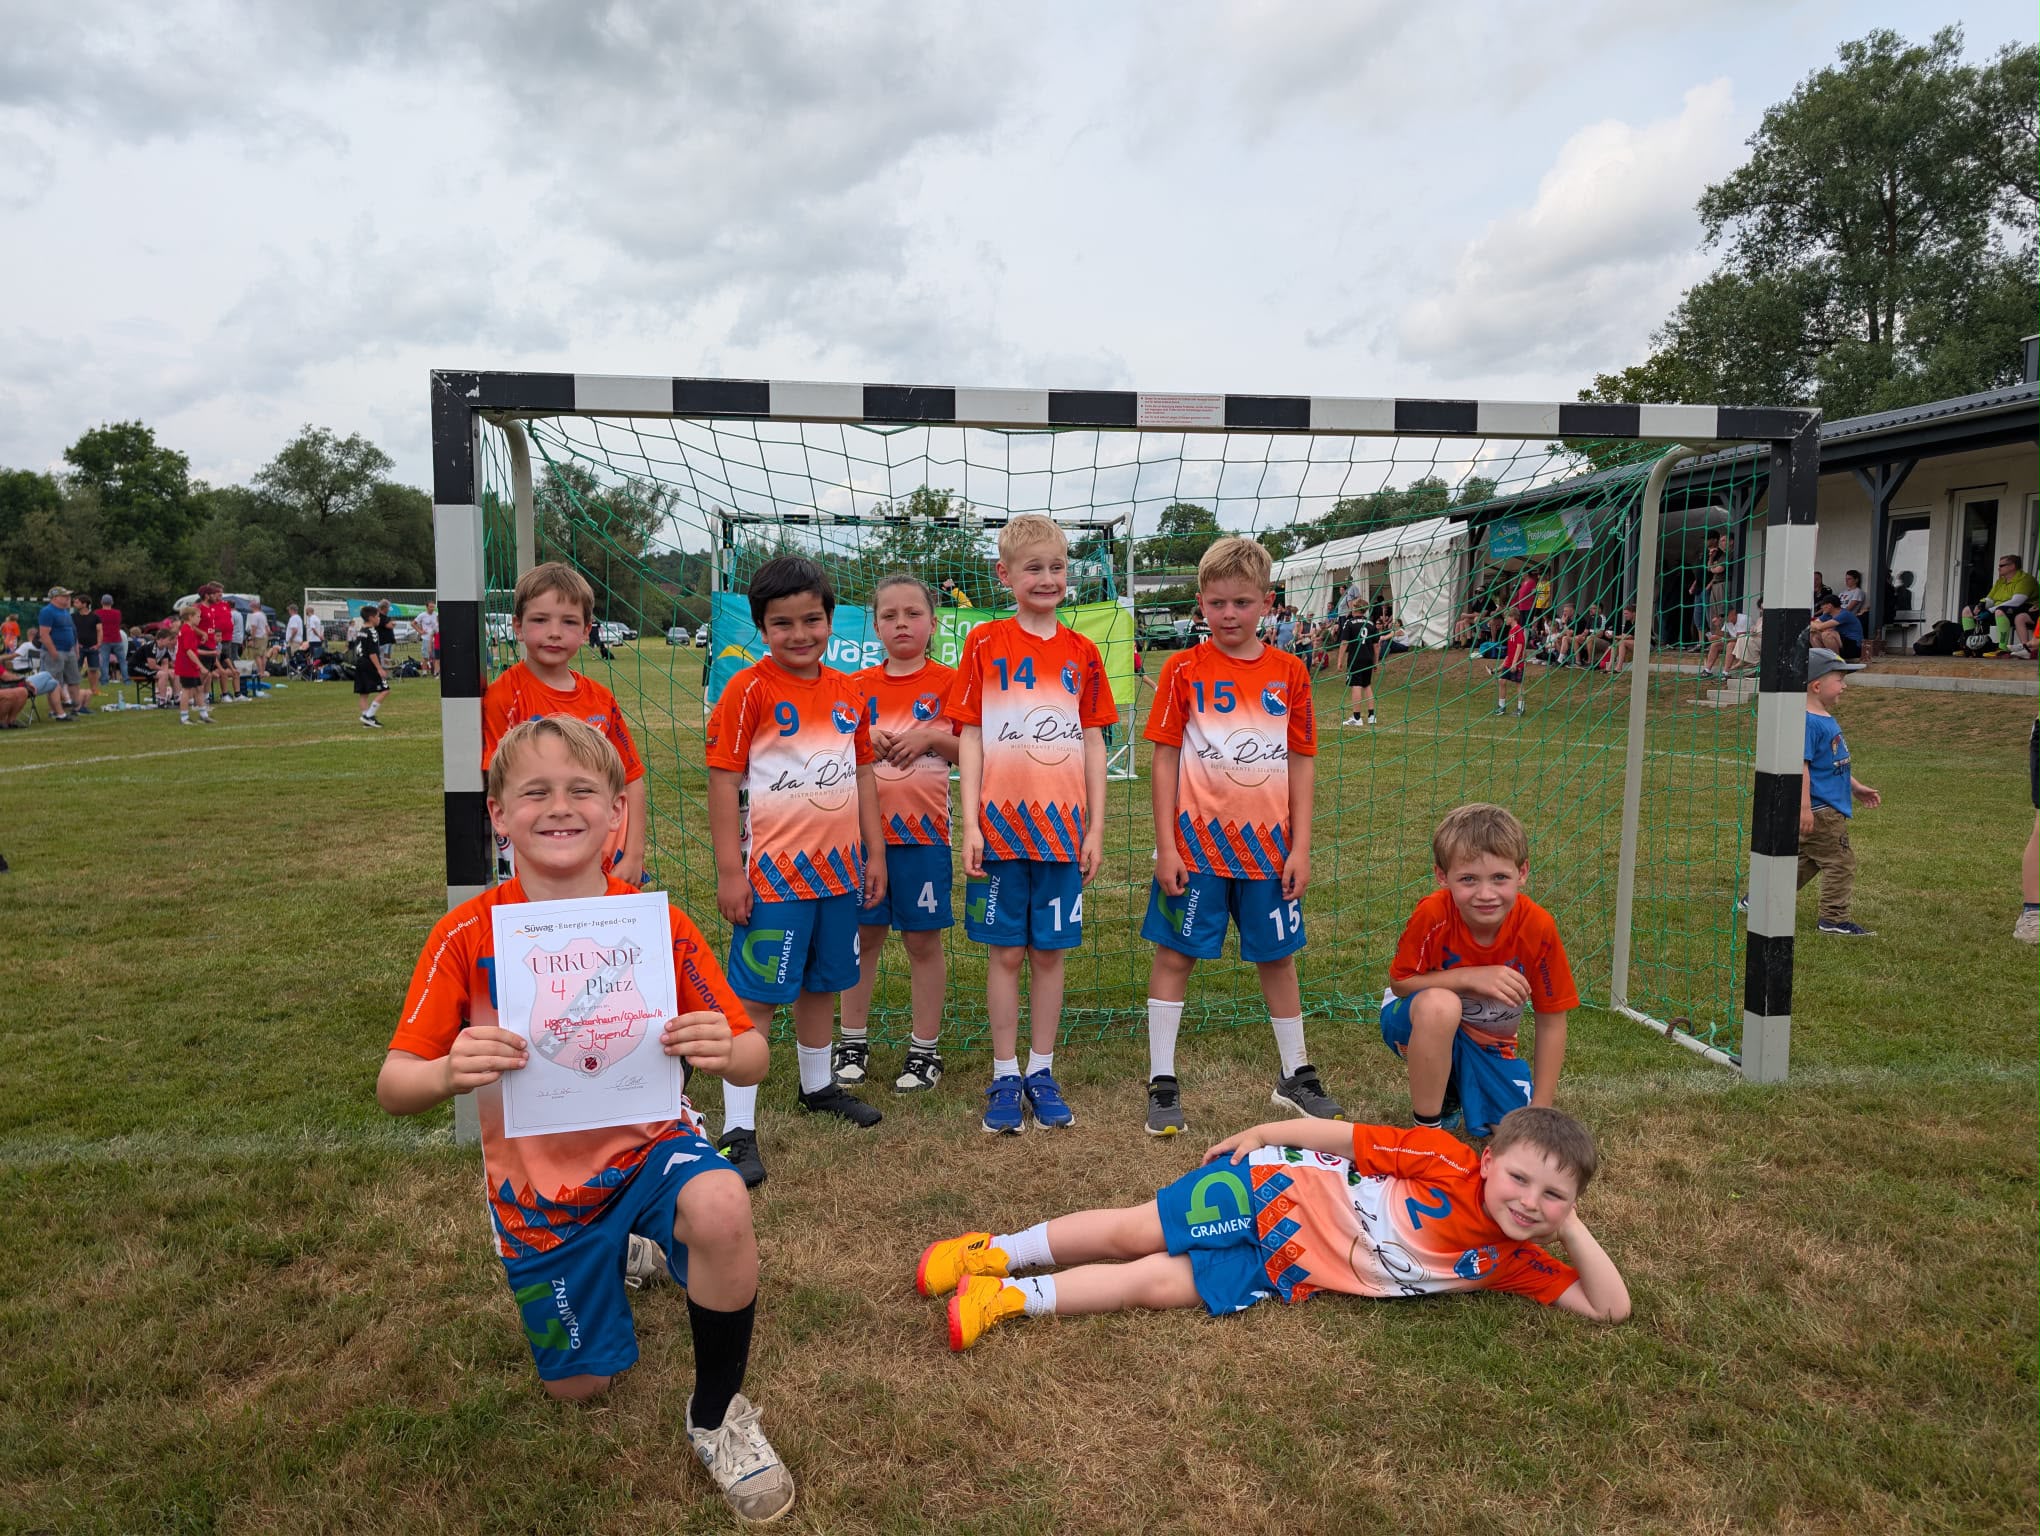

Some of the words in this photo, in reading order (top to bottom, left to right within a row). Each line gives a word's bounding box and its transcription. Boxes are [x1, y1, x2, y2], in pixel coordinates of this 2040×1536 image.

[942, 642, 960, 666] B
[992, 656, 1037, 691] 14
[1192, 681, 1237, 713] 15
[774, 701, 800, 737] 9
[1197, 743, 1224, 760] da
[769, 771, 805, 792] da
[917, 881, 938, 914] 4
[985, 875, 1001, 925] GRAMENZ
[1048, 893, 1083, 932] 14
[1183, 888, 1201, 938] GRAMENZ
[1269, 898, 1301, 942] 15
[532, 947, 643, 975] URKUNDE
[777, 929, 795, 985] GRAMENZ
[586, 975, 633, 996] Platz
[1405, 1187, 1453, 1231] 2
[1190, 1217, 1252, 1239] GRAMENZ
[551, 1276, 582, 1350] GRAMENZ
